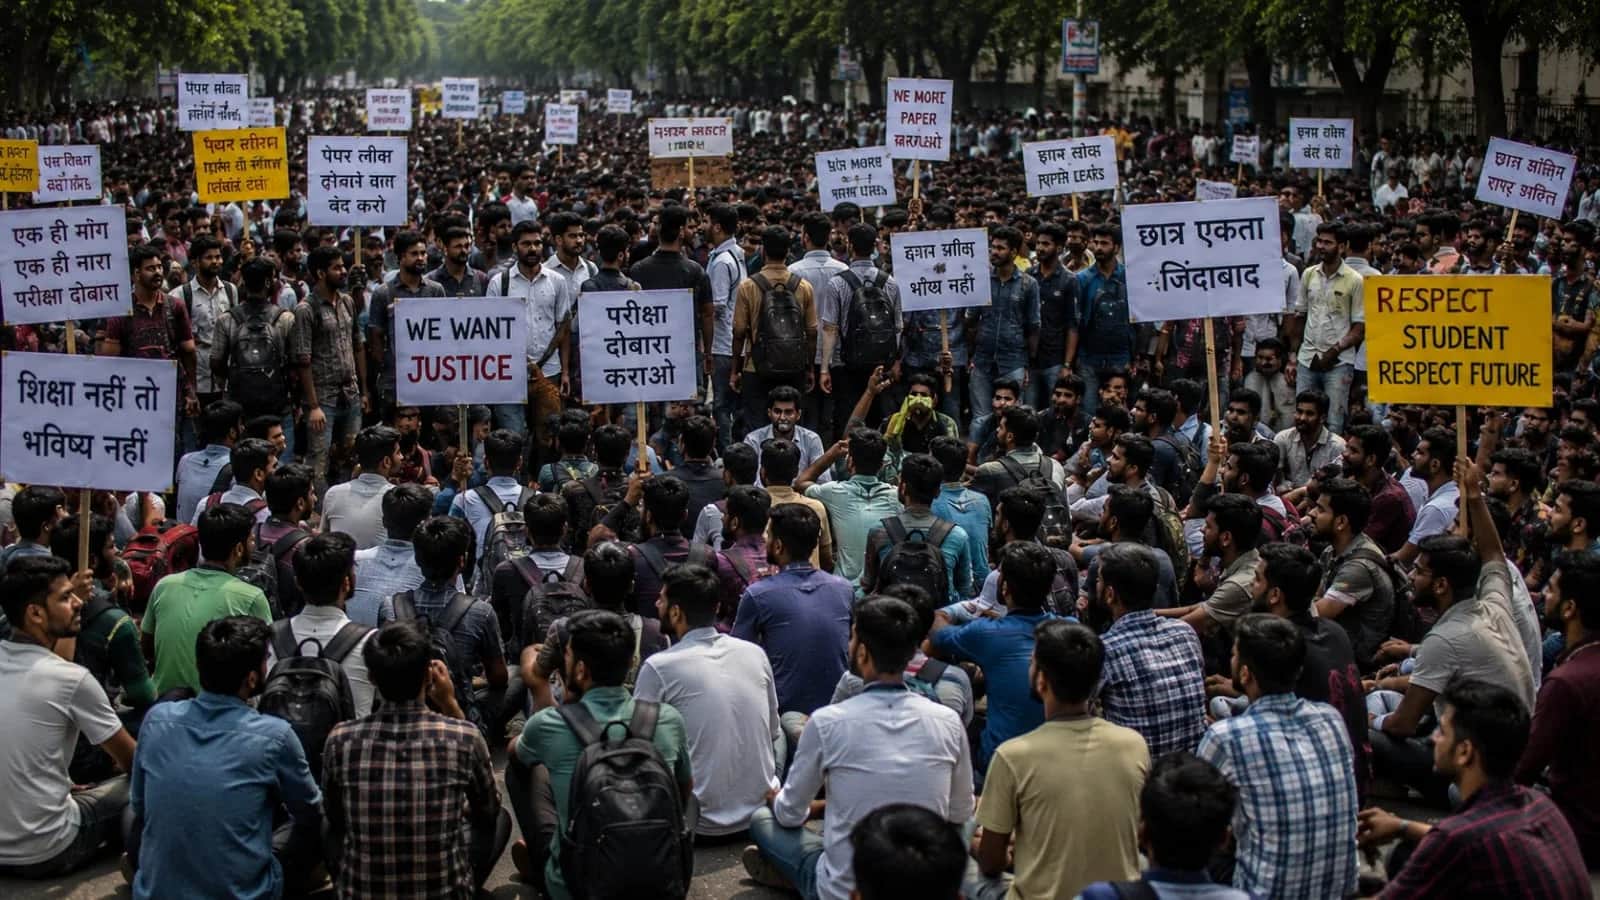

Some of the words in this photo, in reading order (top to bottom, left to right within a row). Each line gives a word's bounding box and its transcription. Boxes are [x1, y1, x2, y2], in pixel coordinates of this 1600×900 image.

[901, 112, 937, 126] PAPER
[320, 145, 353, 165] पेपर
[12, 226, 44, 249] एक
[49, 219, 69, 246] ही
[1135, 221, 1187, 248] छात्र
[1193, 216, 1265, 249] एकता
[14, 258, 46, 280] एक
[50, 250, 71, 277] ही
[75, 252, 112, 273] नारा
[1161, 259, 1260, 293] जिंदाबाद
[14, 285, 64, 310] परीक्षा
[68, 280, 120, 306] दोबारा
[948, 272, 976, 296] नहीं
[605, 299, 669, 326] परीक्षा
[1377, 287, 1494, 313] RESPECT
[406, 318, 442, 341] WE
[450, 316, 516, 340] WANT
[603, 329, 672, 357] दोबारा
[1402, 324, 1510, 351] STUDENT
[408, 354, 513, 384] JUSTICE
[603, 358, 676, 389] कराओ
[1379, 360, 1464, 386] RESPECT
[1470, 362, 1542, 388] FUTURE
[18, 369, 75, 408] शिक्षा
[83, 374, 126, 413] नहीं
[134, 377, 160, 412] तो
[23, 423, 94, 461] भविष्य
[103, 428, 149, 467] नहीं
